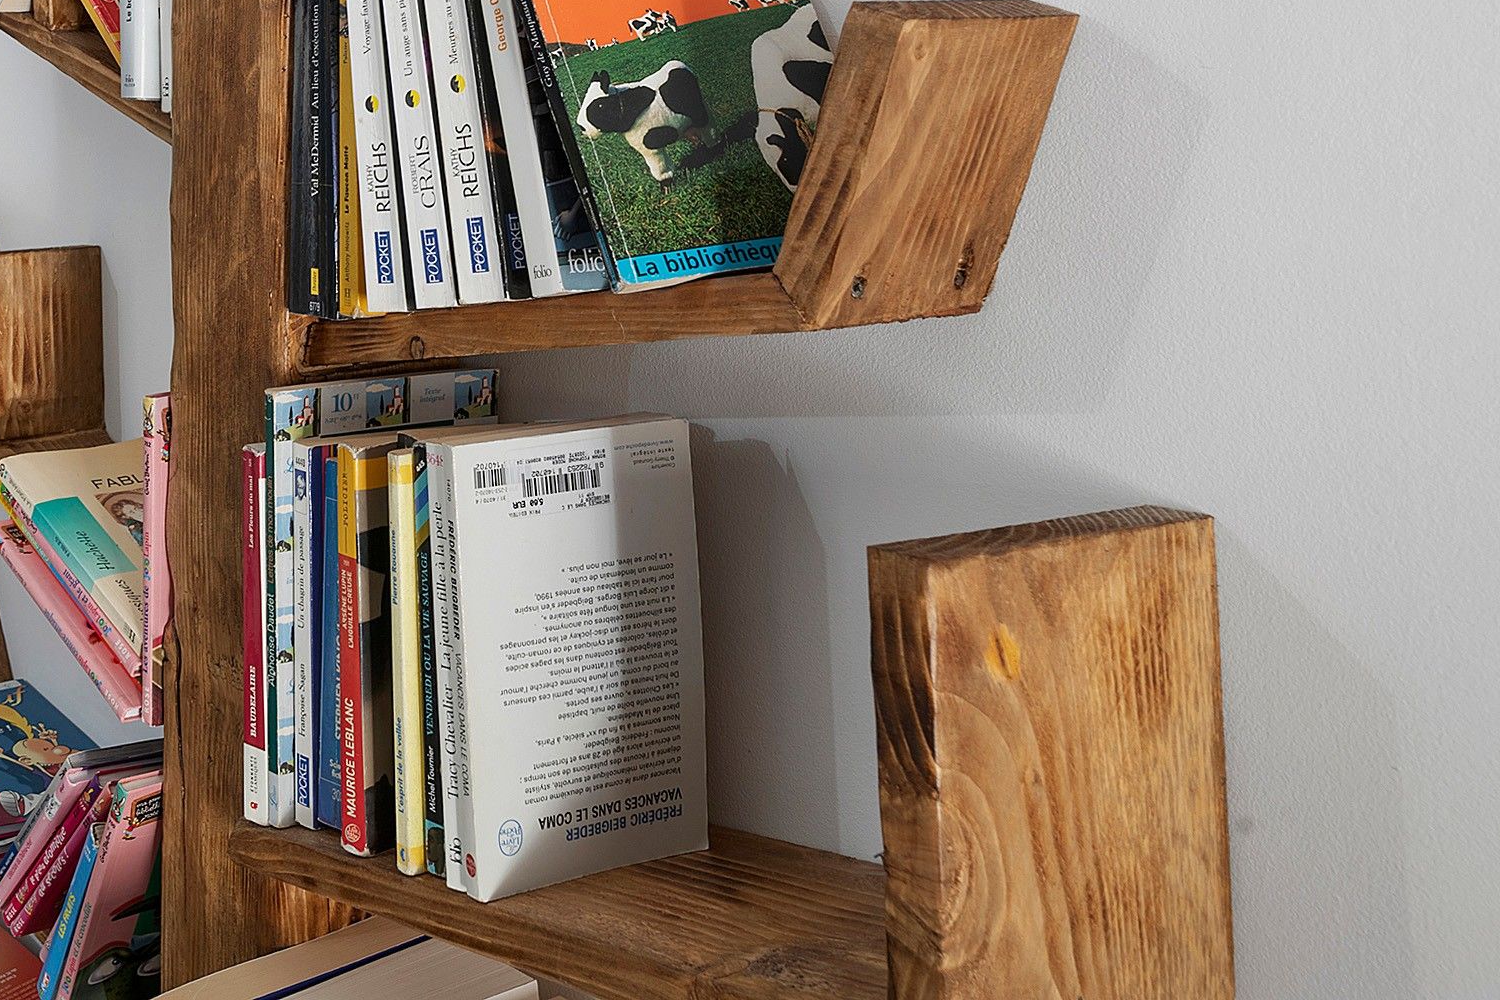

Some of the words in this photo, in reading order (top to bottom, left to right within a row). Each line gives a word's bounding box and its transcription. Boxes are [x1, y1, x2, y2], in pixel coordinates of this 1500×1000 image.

[126, 12, 131, 22] Le
[447, 6, 452, 17] au
[363, 20, 371, 54] Voyage
[449, 21, 458, 64] Meurtres
[494, 8, 507, 51] George
[404, 61, 412, 76] Un
[312, 93, 318, 108] Au
[409, 156, 419, 194] ROBERT
[415, 136, 435, 208] CRAIS
[450, 149, 460, 177] KATHY
[455, 124, 479, 197] REICHS
[366, 165, 374, 192] KATHY
[372, 143, 390, 211] REICHS
[466, 215, 488, 274] POCKET
[633, 256, 659, 277] La
[664, 240, 783, 272] bibliothèqu
[91, 474, 144, 491] FABL
[264, 474, 274, 512] moulin
[265, 511, 274, 536] mon
[433, 502, 446, 540] perle
[76, 531, 114, 571] Hachette
[265, 536, 274, 552] de
[435, 545, 444, 556] la
[266, 552, 275, 584] Lettres
[418, 552, 428, 606] SAUVAGE
[345, 570, 353, 603] CREUSE
[436, 575, 446, 602] fille
[266, 592, 276, 633] Daudet
[298, 615, 304, 628] Un
[345, 604, 353, 648] L'AIGUILLE
[440, 607, 452, 648] jeune
[424, 635, 430, 649] LA
[141, 655, 151, 674] Les
[266, 634, 277, 687] Alphonse
[424, 652, 431, 670] OU
[441, 653, 451, 670] La
[425, 674, 433, 734] VENDREDI
[345, 698, 354, 757] LEBLANC
[393, 715, 401, 749] vallée
[443, 688, 456, 754] Chevalier
[296, 753, 309, 807] POCKET
[346, 759, 356, 817] MAURICE
[395, 775, 405, 813] L'esprit
[448, 763, 459, 798] Tracy
[428, 784, 436, 812] Michel
[590, 800, 620, 818] DANS
[623, 788, 682, 811] VACANCES
[536, 812, 572, 830] COMA
[564, 816, 626, 842] BEIGBEDER
[576, 808, 588, 822] LE
[631, 804, 682, 826] FRÉDÉRIC
[60, 893, 77, 924] FRUITS
[55, 921, 67, 938] LES
